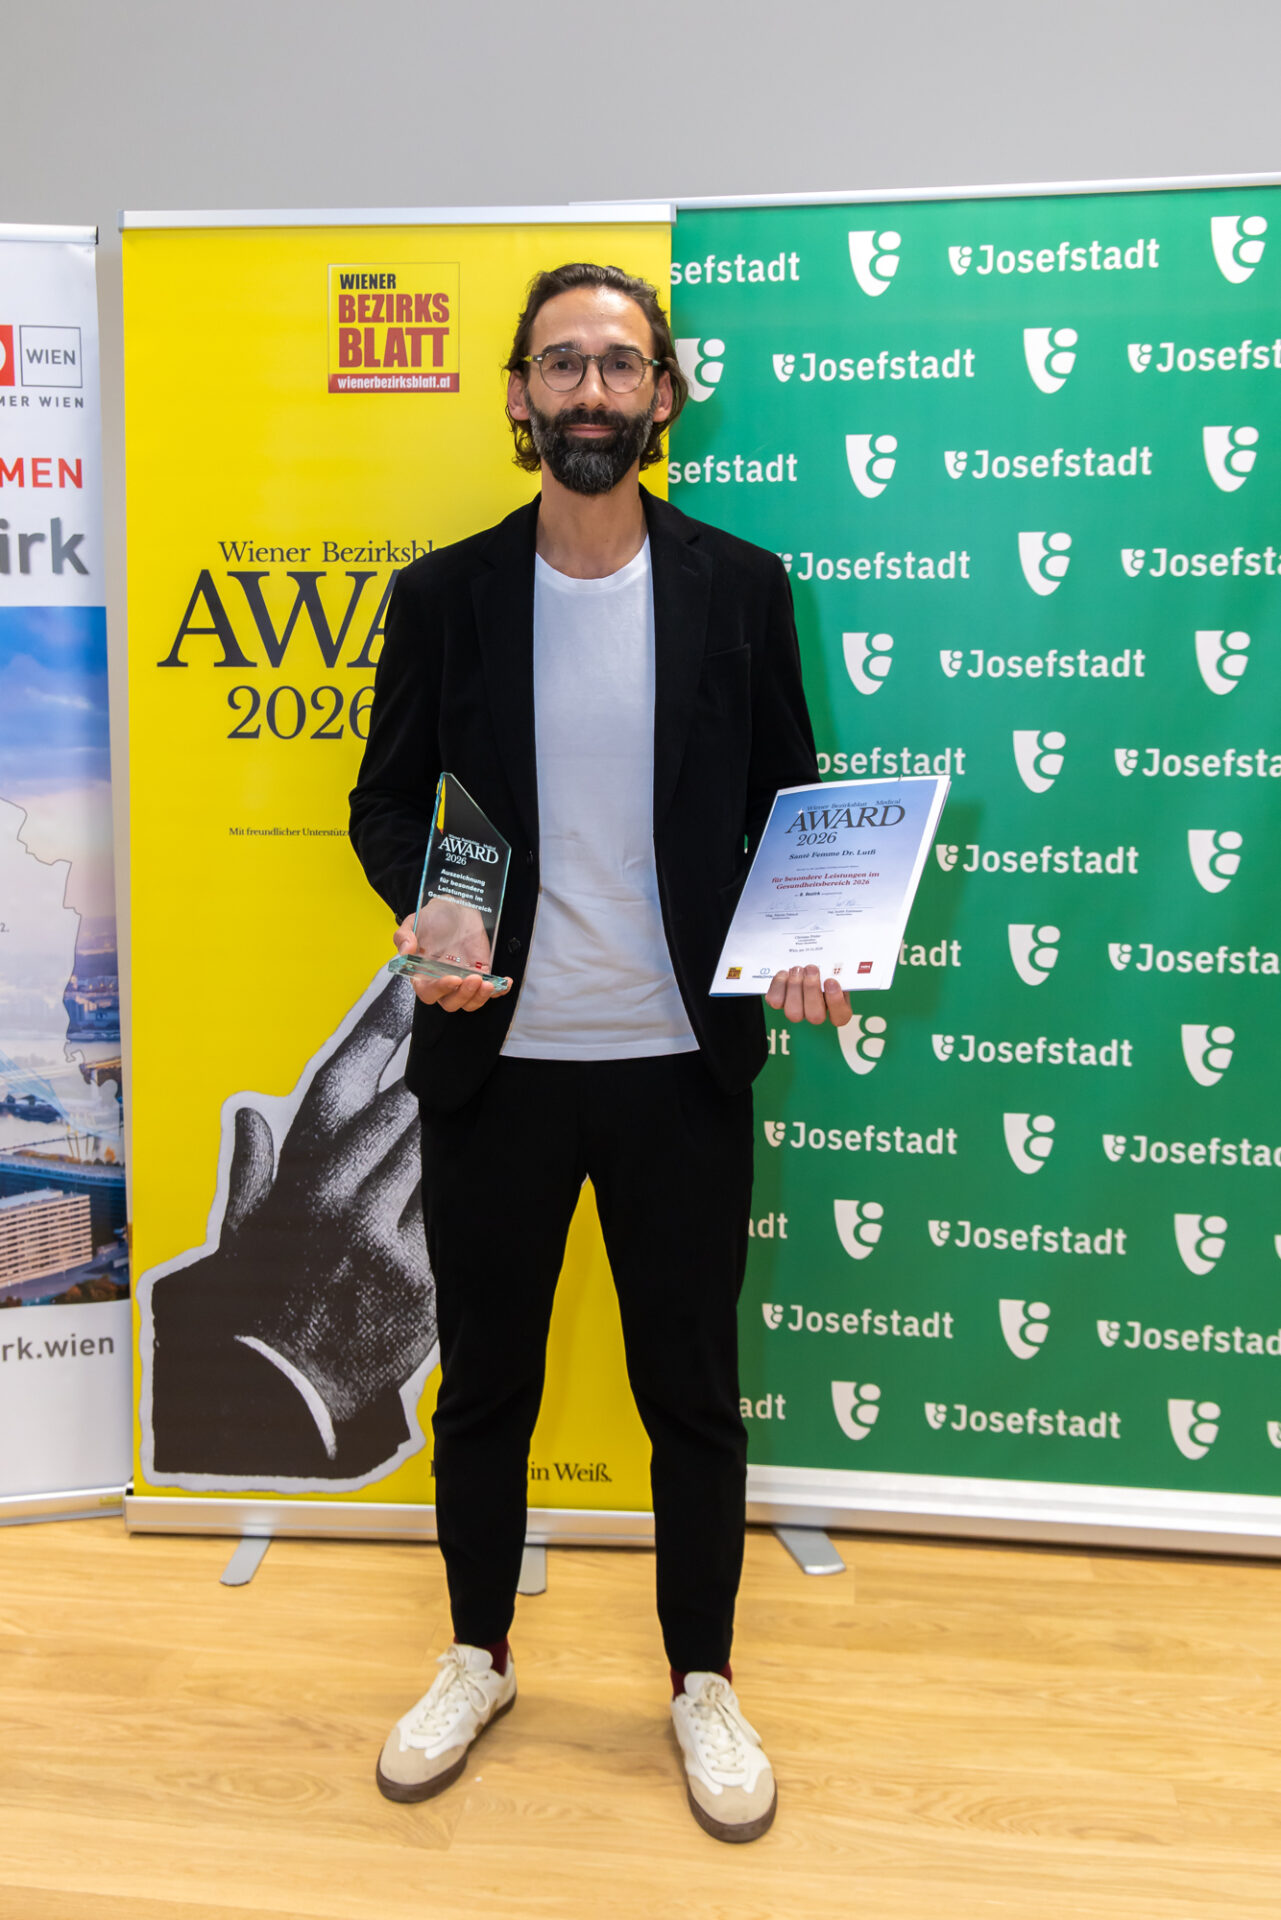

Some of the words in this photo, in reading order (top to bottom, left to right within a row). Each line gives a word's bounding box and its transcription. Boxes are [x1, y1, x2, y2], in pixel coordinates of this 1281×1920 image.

[670, 251, 801, 285] sefstadt
[976, 238, 1160, 275] Josefstadt
[340, 273, 397, 290] WIENER
[338, 292, 450, 324] BEZIRKS
[25, 348, 77, 365] WIEN
[338, 326, 450, 368] BLATT
[799, 348, 976, 382] Josefstadt
[337, 375, 451, 389] wienerbezirksblatt.at
[39, 395, 85, 409] WIEN
[0, 457, 84, 490] MEN
[669, 453, 798, 484] sefstadt
[971, 446, 1153, 480] Josefstadt
[217, 540, 311, 563] Wiener
[797, 550, 971, 581] Josefstadt
[1149, 546, 1281, 578] Josefst
[967, 649, 1146, 679] Josefstadt
[226, 685, 376, 740] 2026
[229, 827, 245, 836] Mit
[246, 827, 301, 837] freundlicher
[302, 827, 350, 837] Unterstütz
[784, 805, 906, 834] AWARD
[438, 836, 499, 864] AWARD
[796, 831, 838, 847] 2026
[445, 852, 467, 866] 2026
[962, 844, 1139, 875] Josefstadt
[439, 877, 450, 885] für
[450, 879, 485, 894] besondere
[441, 869, 486, 887] Auszeichnung
[776, 880, 851, 890] Gesundheitsbereich
[784, 874, 823, 882] besondere
[824, 872, 867, 880] Leistungen
[428, 891, 492, 913] Gesundheitsbereich
[437, 885, 474, 900] Leistungen
[1135, 943, 1281, 975] Josefsta
[958, 1034, 1133, 1067] Josefstadt
[790, 1121, 958, 1155] Josefstadt
[954, 1220, 1127, 1255] Josefstadt
[787, 1304, 954, 1339] Josefstadt
[2, 1333, 115, 1362] rk.wien
[951, 1404, 1122, 1439] Josefstadt
[530, 1461, 550, 1481] in
